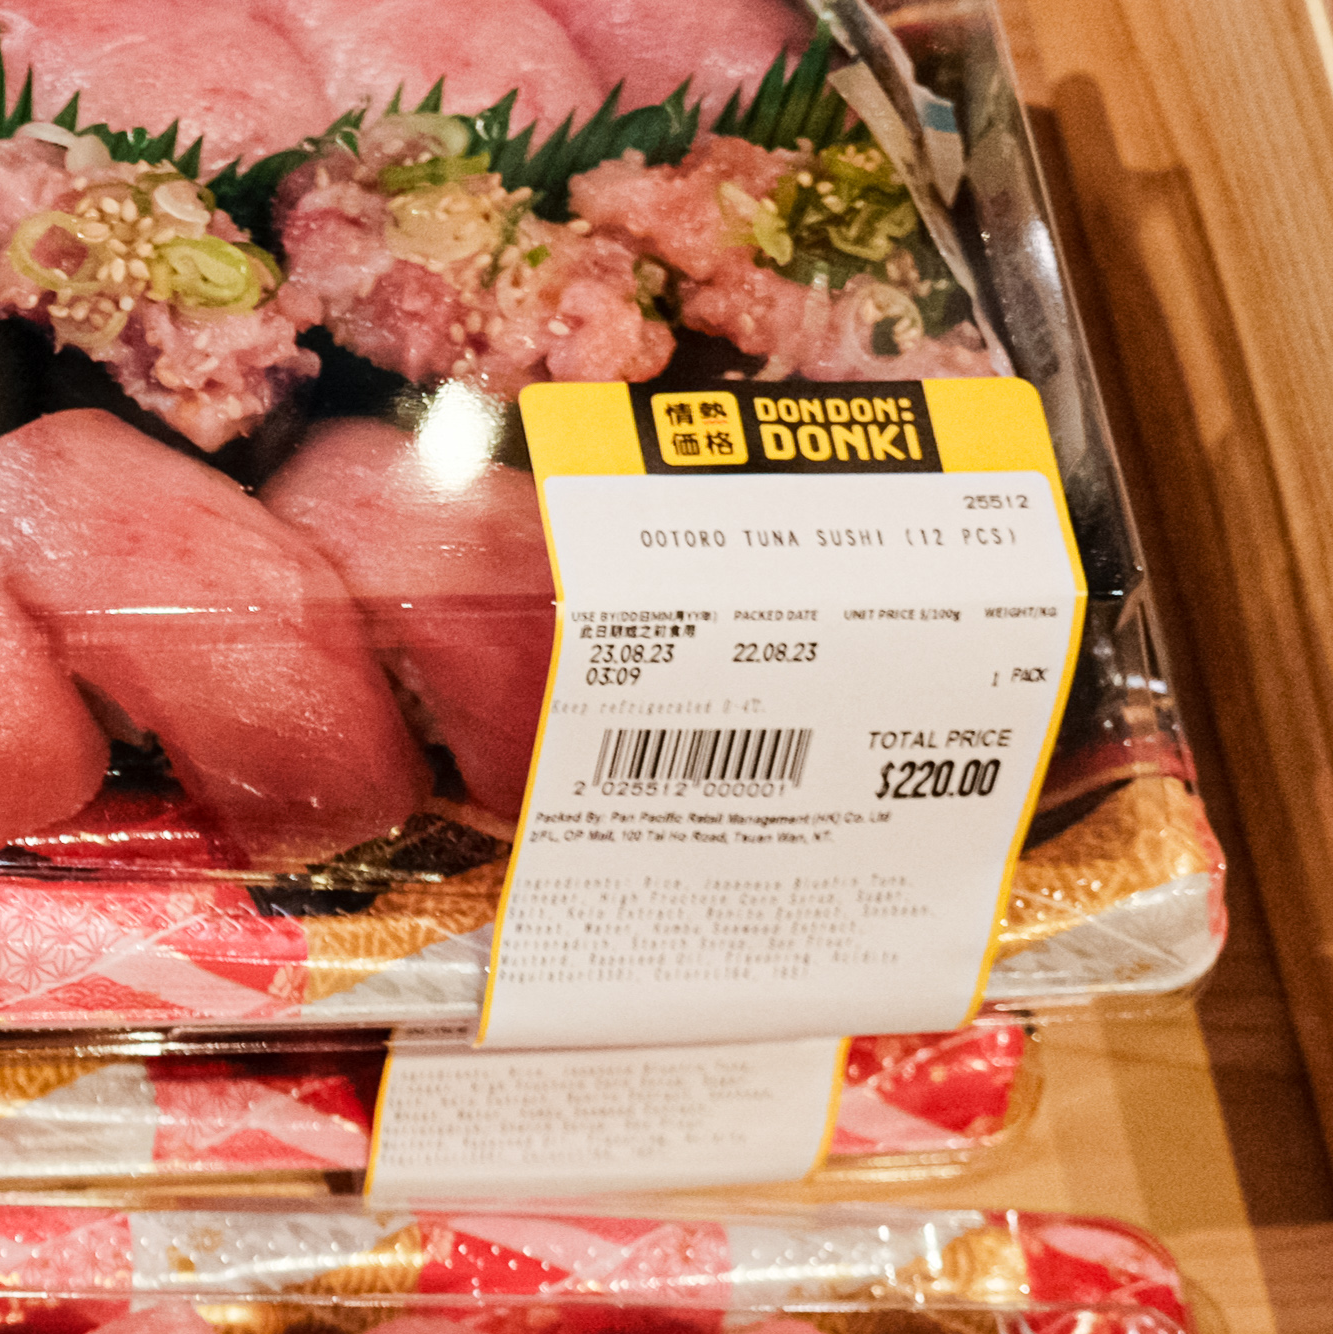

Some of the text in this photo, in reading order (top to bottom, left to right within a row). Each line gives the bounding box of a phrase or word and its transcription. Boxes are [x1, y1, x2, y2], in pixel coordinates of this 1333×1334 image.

[759, 424, 923, 462] DONKI
[963, 494, 1029, 510] 25512
[640, 527, 1016, 548] OOTORO TUNA SUSHI (12 PCS)
[733, 609, 818, 622] PACKED DATE
[984, 606, 1058, 619] WEIGHT/KG
[590, 643, 675, 664] 23.08.23
[732, 642, 818, 663] 22.08.23
[585, 666, 641, 686] 03:09
[1012, 667, 1046, 683] PACK
[869, 728, 1013, 750] TOTAL PRICE
[875, 758, 1002, 800] $220.00
